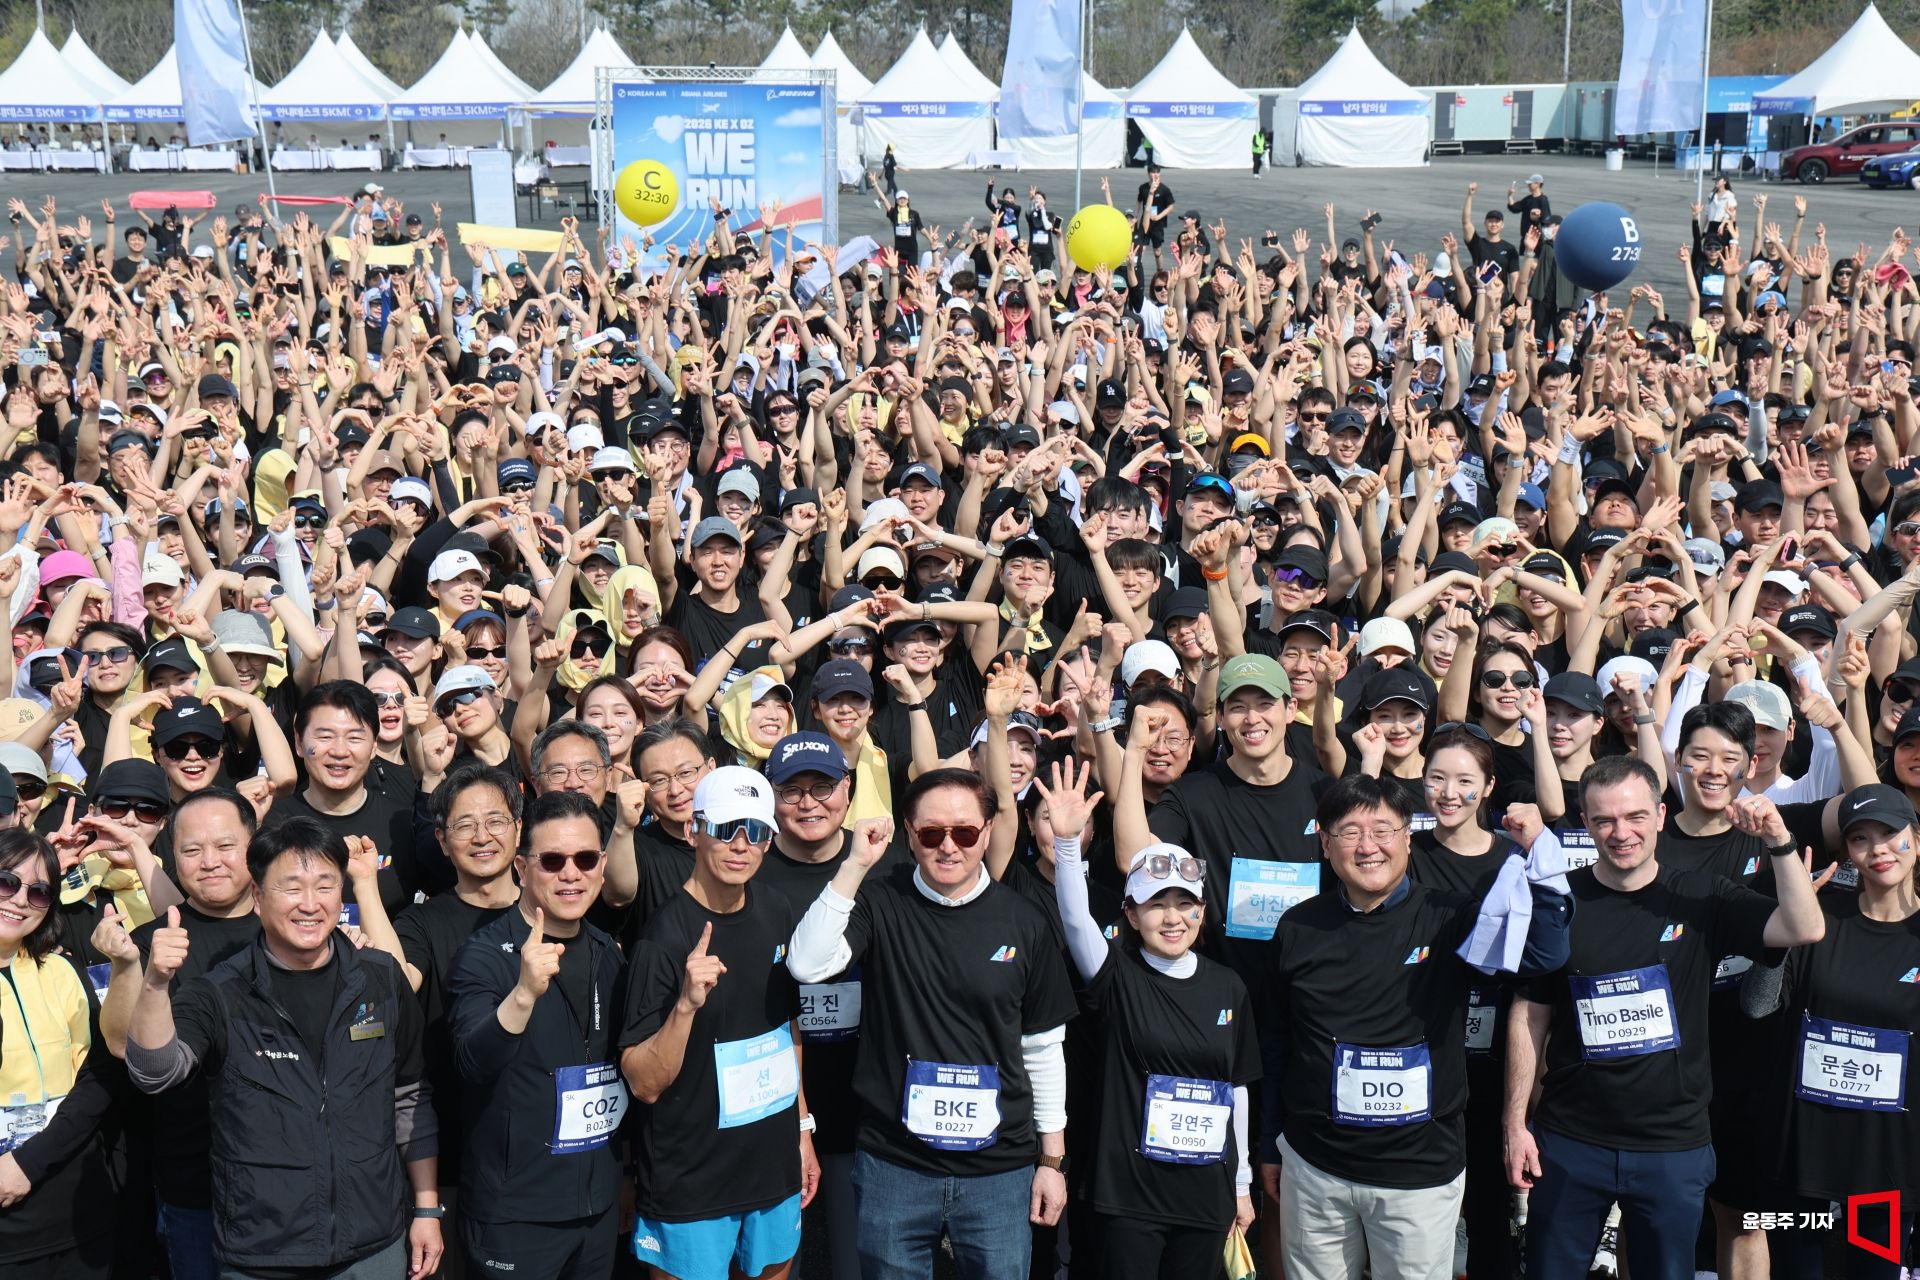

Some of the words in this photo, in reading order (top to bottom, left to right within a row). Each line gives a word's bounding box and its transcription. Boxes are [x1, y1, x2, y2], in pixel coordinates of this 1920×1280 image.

[134, 107, 179, 119] 안내데스크
[275, 107, 320, 117] 안내데스크
[419, 106, 462, 117] 안내데스크
[901, 104, 919, 114] 여자
[920, 104, 946, 115] 탈의실
[1170, 105, 1187, 115] 여자
[1189, 104, 1214, 115] 탈의실
[1342, 103, 1360, 114] 남자
[1361, 103, 1387, 113] 탈의실
[684, 119, 712, 130] 2026
[714, 119, 729, 130] KE
[730, 119, 738, 130] X
[684, 132, 756, 175] WE
[643, 170, 661, 190] C
[633, 188, 670, 205] 32:30
[686, 178, 756, 210] RUN
[1619, 216, 1640, 243] B
[1449, 505, 1463, 514] alo
[782, 742, 830, 762] SRIXON
[1563, 836, 1577, 846] WE
[1596, 982, 1615, 995] WE
[1615, 979, 1640, 993] RUN
[801, 1017, 809, 1027] C
[811, 1016, 838, 1027] 0564
[1583, 1010, 1617, 1027] Tino
[1620, 1003, 1664, 1023] Basile
[1607, 1030, 1616, 1039] D
[1618, 1026, 1646, 1038] 0929
[1831, 1030, 1850, 1044] WE
[1850, 1033, 1876, 1049] RUN
[1808, 1043, 1818, 1051] 5K
[1361, 1056, 1378, 1067] WE
[1379, 1057, 1403, 1068] RUN
[1821, 1054, 1883, 1082] 문슬아
[586, 1073, 600, 1086] WE
[600, 1068, 617, 1083] RUN
[756, 1066, 771, 1089] 션
[937, 1072, 955, 1084] WE
[955, 1073, 979, 1086] RUN
[1341, 1069, 1350, 1077] 5K
[1362, 1081, 1404, 1098] DIO
[1829, 1078, 1839, 1087] D
[1840, 1080, 1871, 1092] 0777
[565, 1094, 576, 1102] 5K
[1175, 1087, 1191, 1099] WE
[1191, 1088, 1212, 1102] RUN
[582, 1095, 619, 1119] COZ
[934, 1099, 978, 1119] BKE
[1364, 1102, 1372, 1111] B
[1374, 1102, 1402, 1111] 0232
[586, 1123, 592, 1133] B
[593, 1117, 614, 1132] 0228
[935, 1121, 943, 1131] B
[944, 1122, 974, 1133] 0227
[1170, 1113, 1213, 1133] 길연주
[1172, 1136, 1180, 1145] D
[1181, 1136, 1206, 1147] 0950
